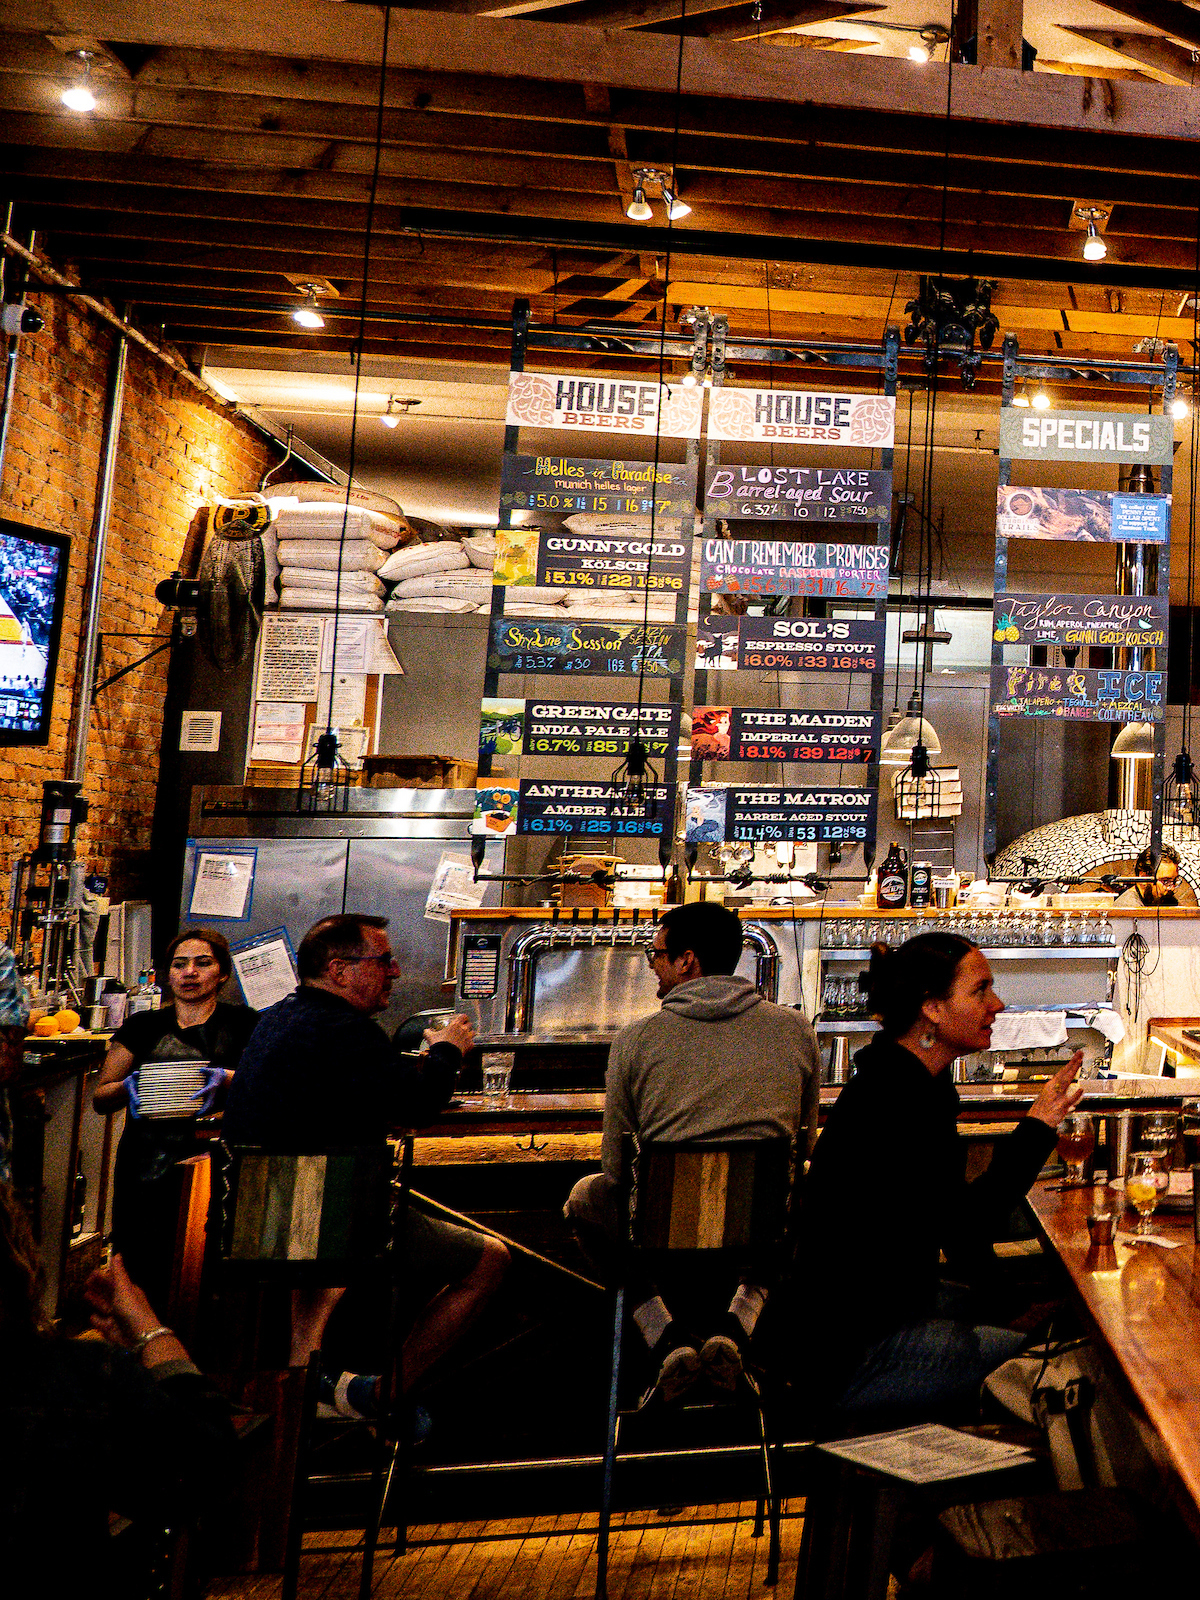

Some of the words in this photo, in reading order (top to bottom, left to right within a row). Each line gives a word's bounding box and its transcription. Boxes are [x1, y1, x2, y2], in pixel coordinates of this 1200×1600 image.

[555, 380, 657, 416] HOUSE
[755, 394, 851, 427] HOUSE
[562, 412, 645, 430] BEERS
[761, 425, 841, 440] BEERS
[1023, 418, 1150, 452] SPECIALS
[535, 456, 585, 477] Helles
[612, 460, 672, 484] Paradise
[742, 467, 809, 485] LOST
[817, 470, 869, 486] LAKE
[554, 479, 592, 490] munich
[594, 481, 621, 491] helles
[623, 482, 646, 495] lager
[829, 486, 873, 503] Sour
[537, 494, 559, 509] 5.0
[593, 497, 608, 511] 15
[625, 499, 639, 513] 16
[793, 507, 808, 518] 10
[823, 507, 837, 518] 12
[705, 539, 750, 564] CAN'T
[751, 540, 816, 567] REMEMBER
[826, 543, 889, 570] PROMISES
[553, 571, 594, 586] 5.1%
[608, 574, 632, 587] 22
[665, 576, 683, 589] $6
[715, 565, 775, 576] CHOCOLATE
[838, 568, 881, 581] PORTER
[805, 577, 823, 595] 31
[835, 580, 849, 596] 16
[997, 596, 1079, 630] Taylor
[1083, 600, 1161, 632] Canyon
[773, 621, 850, 639] SOL'S
[1065, 630, 1098, 644] GUNNI
[1125, 631, 1164, 646] KOLSCH
[566, 628, 622, 651] Session
[745, 640, 823, 652] ESPRESSO
[825, 642, 876, 654] STOUT
[574, 658, 591, 669] 30
[750, 654, 793, 668] 6.0%
[804, 655, 828, 668] 33
[832, 656, 851, 669] 16
[859, 657, 876, 669] $6
[1070, 674, 1088, 698] &
[1097, 671, 1163, 702] ICE
[1062, 697, 1099, 708] TEQUILA
[1108, 702, 1146, 711] MEZCAL
[531, 704, 672, 722] GREENGATE
[741, 712, 786, 726] THE
[789, 714, 874, 728] MAIDEN
[1097, 709, 1155, 722] COINTREAU
[530, 724, 582, 735] INDIA
[584, 725, 630, 737] PALE
[632, 727, 669, 738] ALE
[741, 732, 819, 743] IMPERIAL
[821, 733, 871, 744] STOUT
[536, 738, 580, 752] 6.7%
[593, 741, 618, 753] 85
[652, 741, 669, 754] $7
[746, 745, 786, 759] 8.1%
[799, 747, 823, 760] 39
[827, 747, 847, 760] 12
[735, 792, 781, 805] THE
[783, 793, 872, 806] MATRON
[542, 804, 607, 816] AMBER
[610, 806, 646, 817] ALE
[734, 812, 788, 821] BARREL
[789, 813, 824, 822] AGED
[825, 813, 868, 822] STOUT
[530, 818, 573, 832] 6.1%
[587, 820, 612, 833] 25
[616, 821, 637, 834] 16
[645, 821, 663, 834] $6
[739, 824, 783, 841] 11.4%
[797, 826, 816, 840] 53
[823, 826, 843, 838] 12
[850, 826, 867, 838] $8
